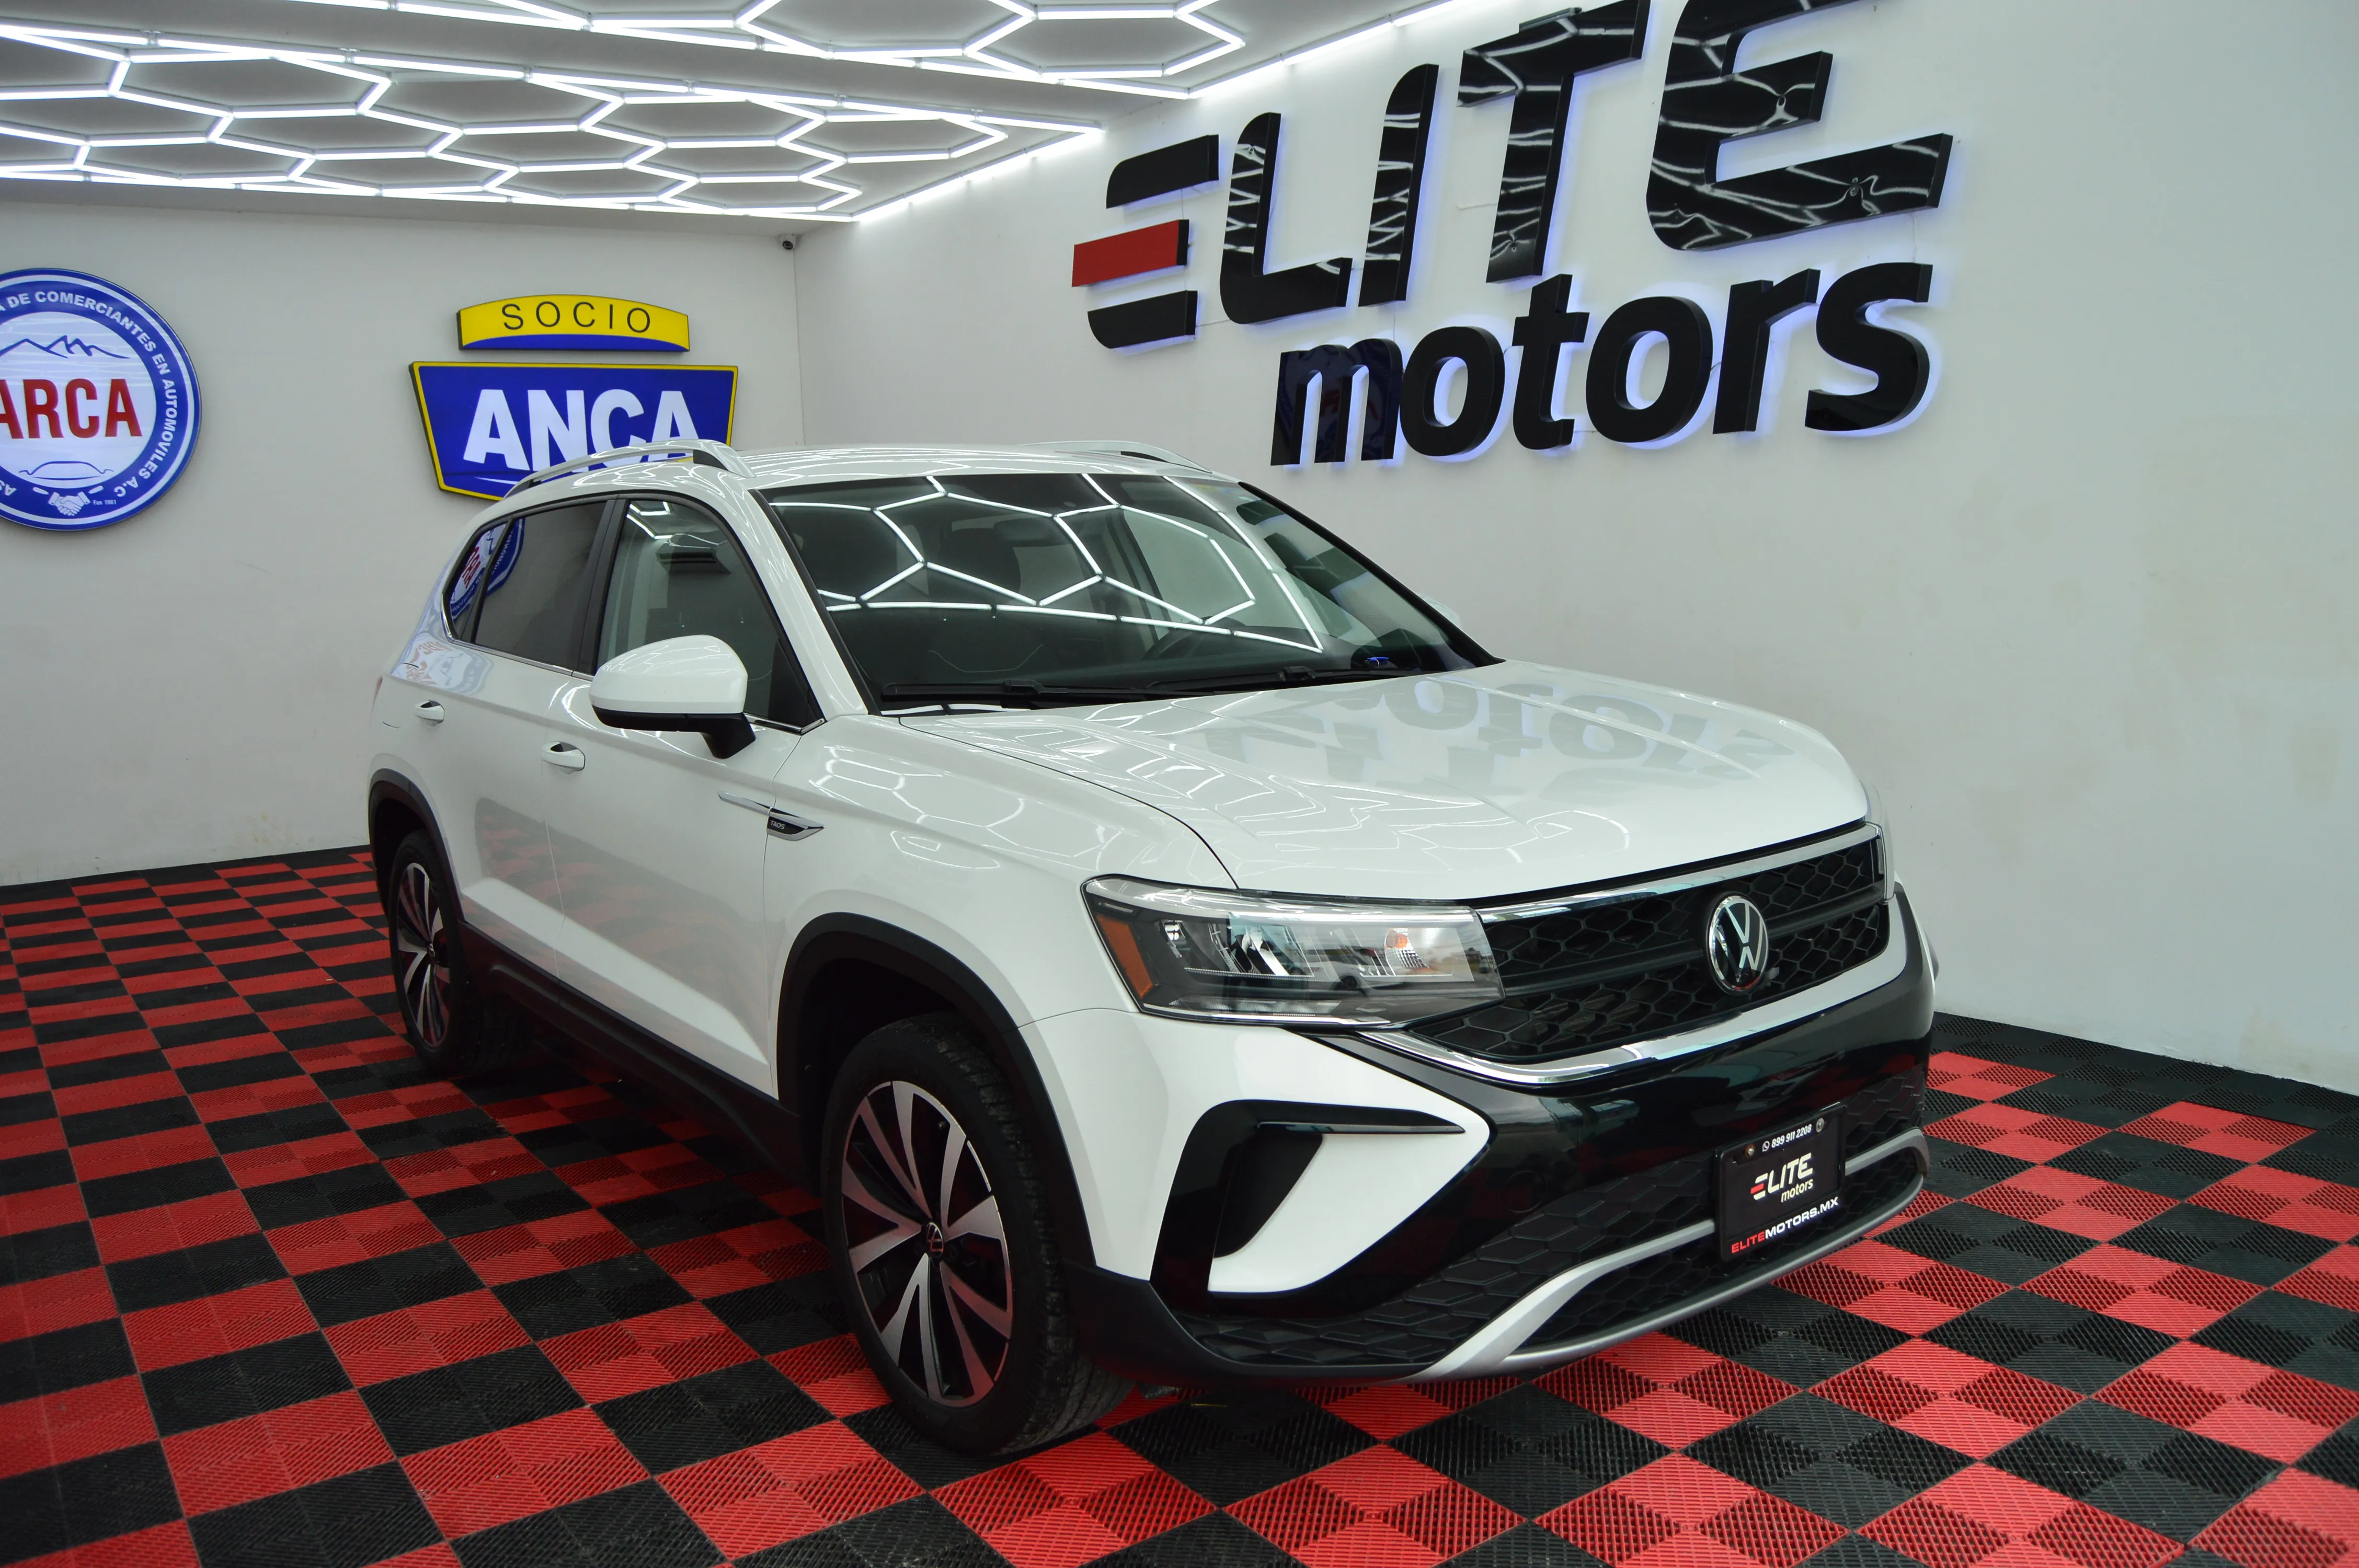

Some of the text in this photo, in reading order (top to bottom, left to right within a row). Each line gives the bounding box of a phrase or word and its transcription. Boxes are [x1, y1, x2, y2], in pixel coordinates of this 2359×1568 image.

[1072, 0, 1953, 349] ELITE
[7, 293, 31, 308] DE
[35, 291, 156, 352] COMERCIANTES
[502, 301, 650, 333] SOCIO
[152, 353, 170, 375] EN
[1270, 262, 1933, 466] motors
[139, 379, 177, 479] AUTOMOVILES
[463, 389, 699, 473] ANCA
[771, 821, 785, 829] TAOS
[1771, 1124, 1812, 1148] 899 911 2208
[1750, 1152, 1813, 1200] ELITE
[1781, 1179, 1813, 1202] motors
[1732, 1196, 1838, 1253] ELITEMOTORS.MX
